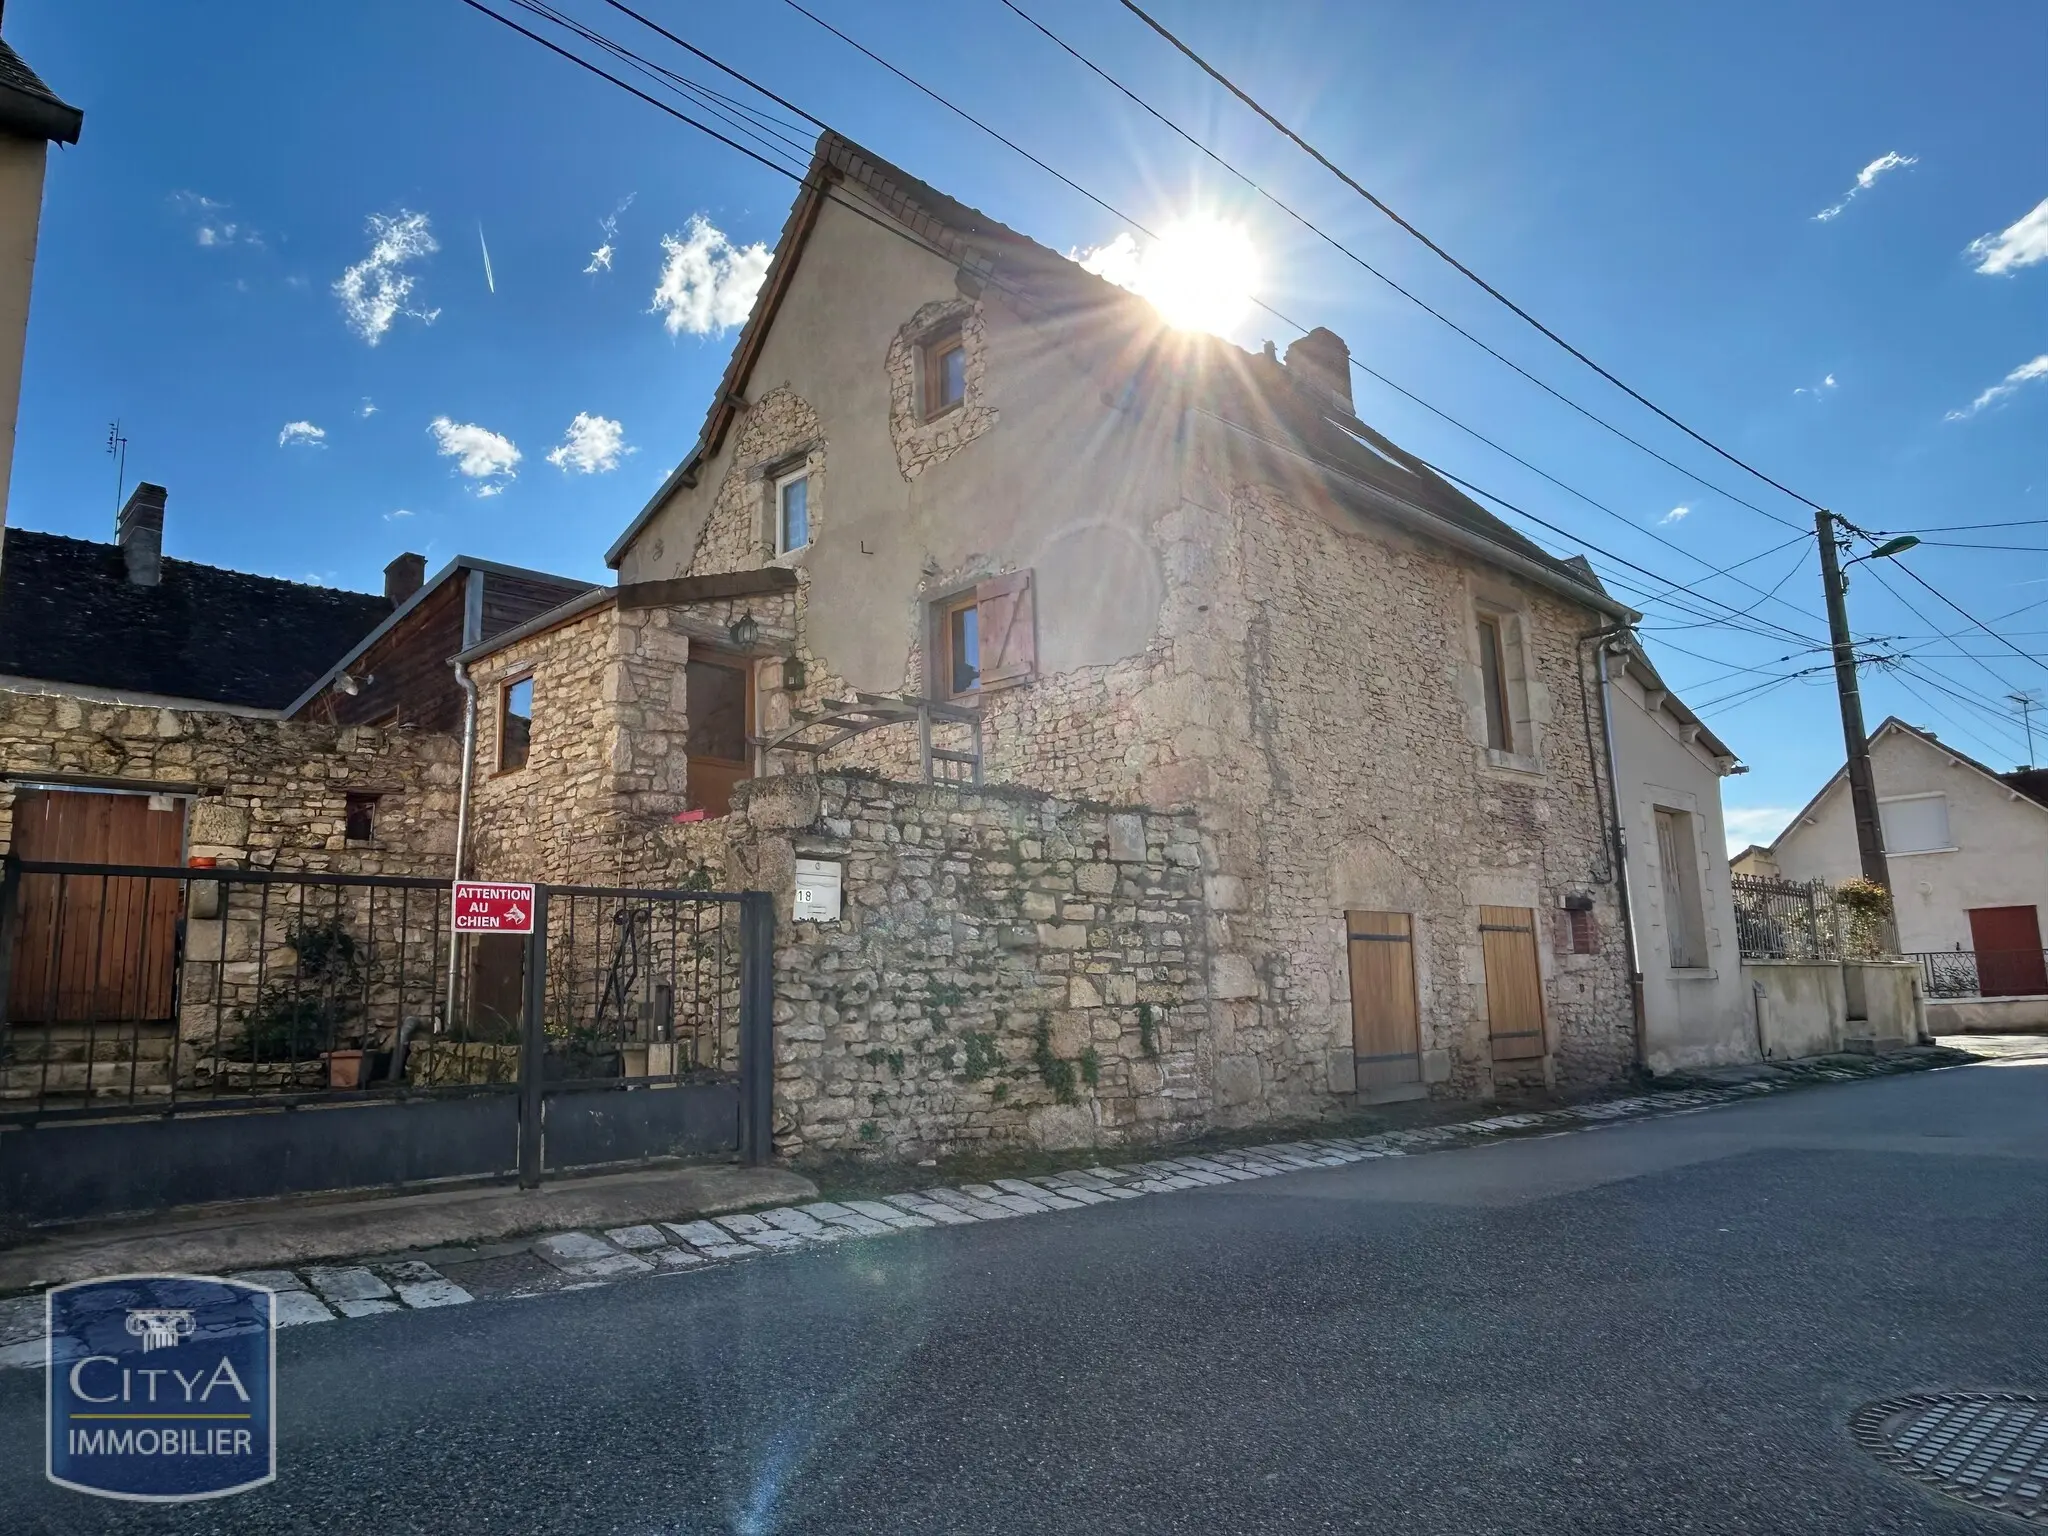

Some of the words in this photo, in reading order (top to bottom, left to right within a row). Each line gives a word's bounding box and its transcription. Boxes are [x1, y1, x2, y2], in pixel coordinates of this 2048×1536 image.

[458, 887, 530, 901] ATTENTION
[798, 890, 812, 902] 18
[469, 902, 489, 913] AU
[457, 915, 500, 928] CHIEN
